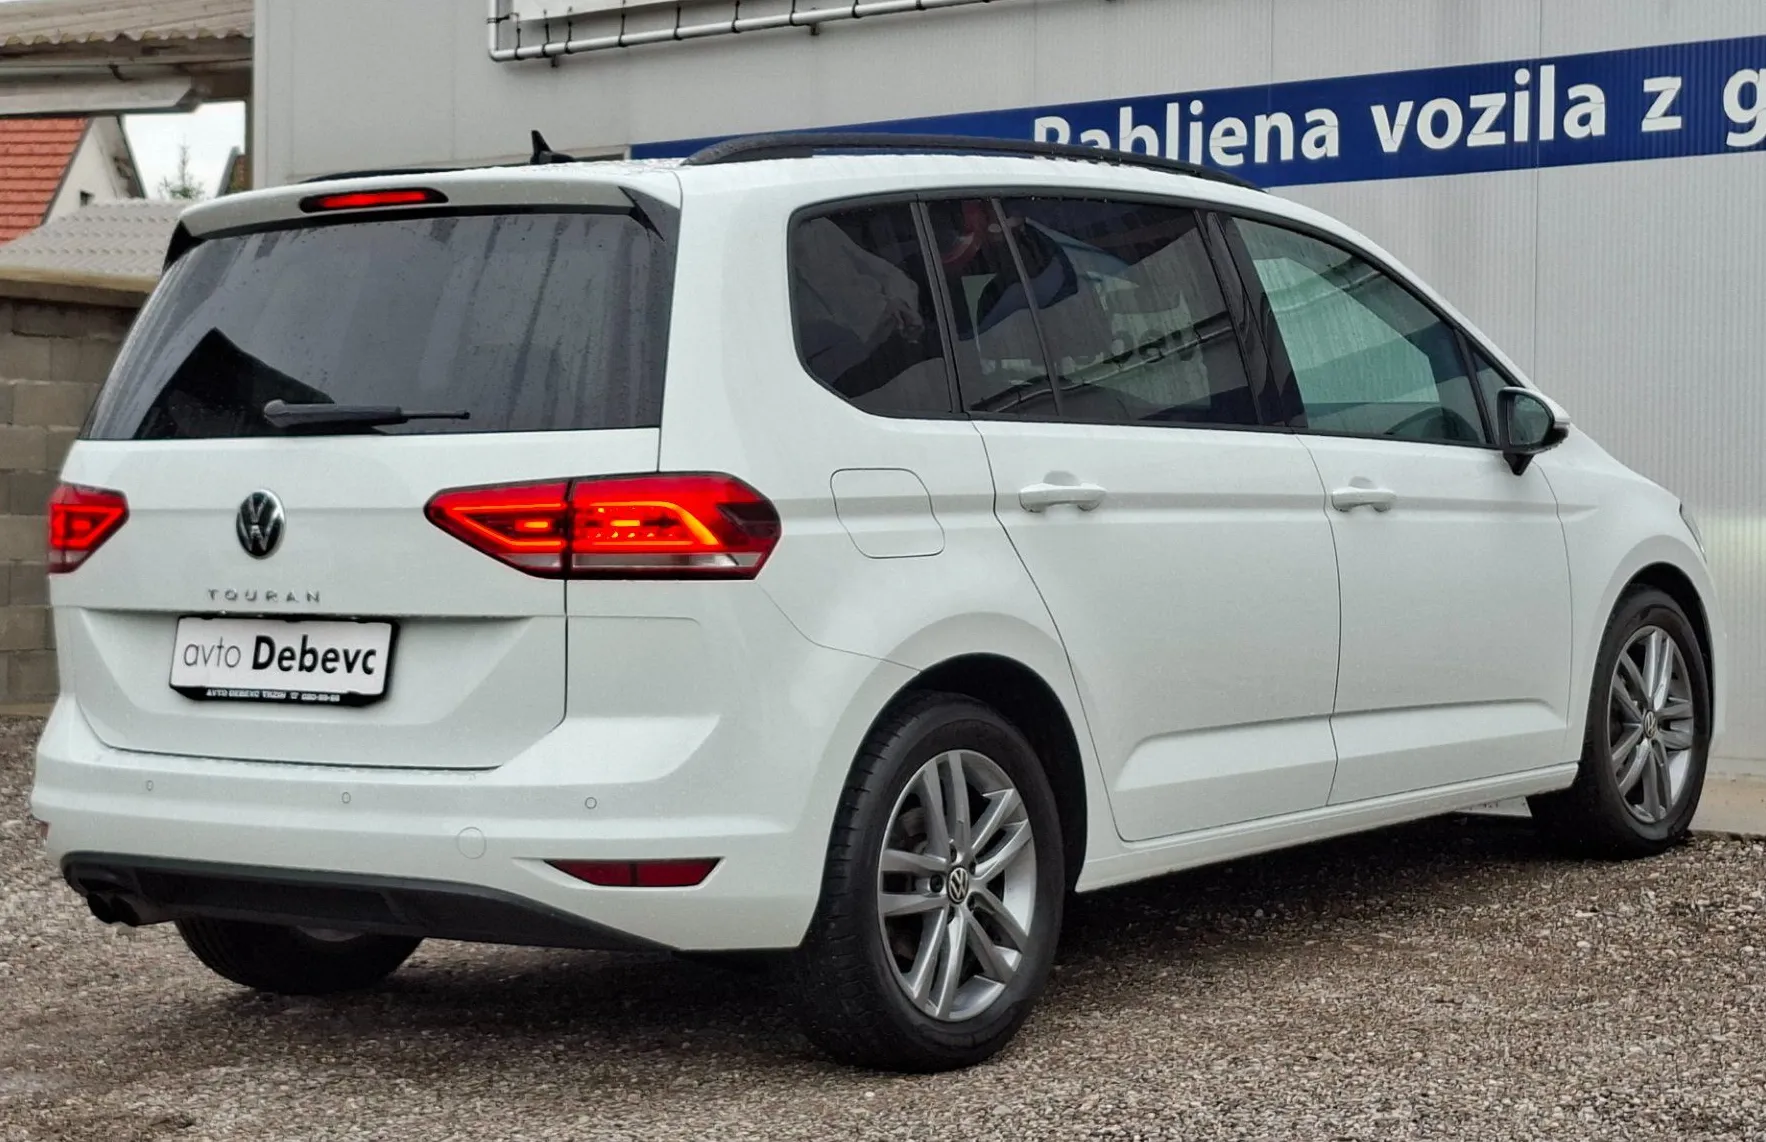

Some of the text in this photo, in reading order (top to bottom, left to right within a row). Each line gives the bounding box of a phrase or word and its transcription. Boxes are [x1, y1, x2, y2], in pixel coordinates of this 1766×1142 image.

[1370, 64, 1606, 153] vozila
[1641, 76, 1682, 132] z
[208, 588, 320, 603] TOURAN
[183, 634, 377, 675] avto Debevc
